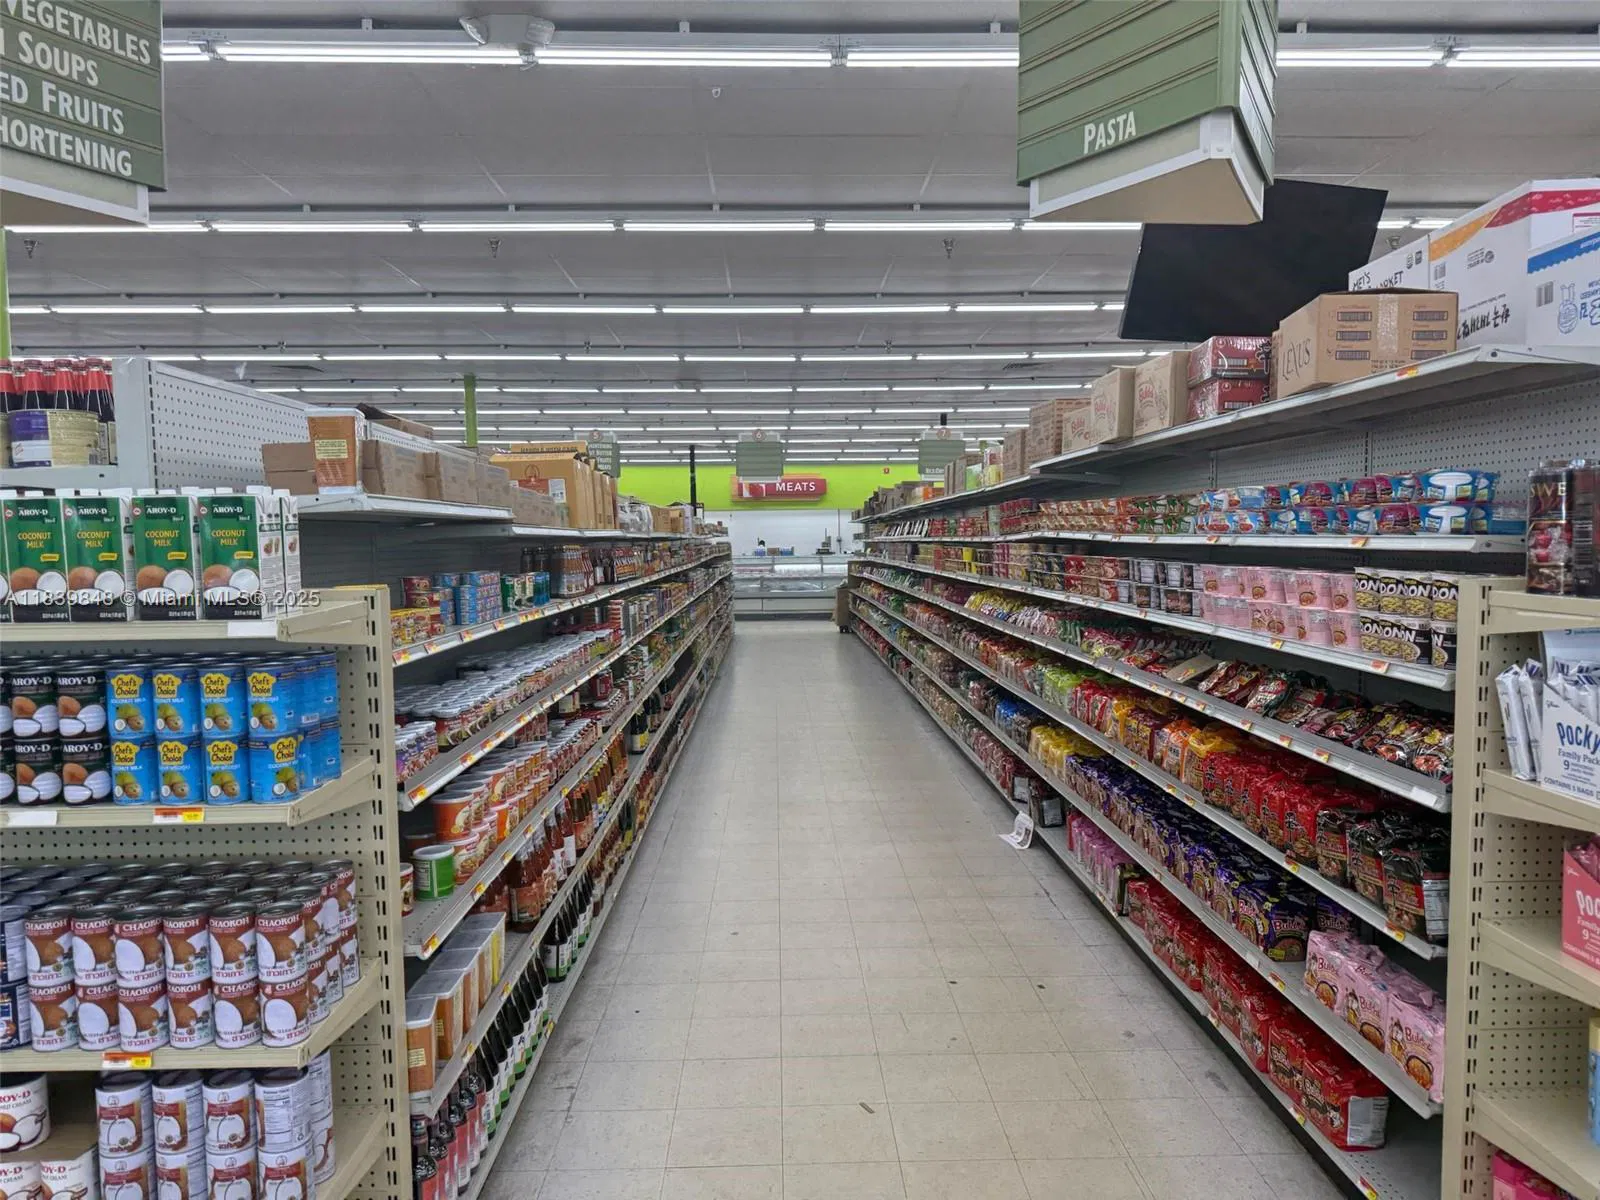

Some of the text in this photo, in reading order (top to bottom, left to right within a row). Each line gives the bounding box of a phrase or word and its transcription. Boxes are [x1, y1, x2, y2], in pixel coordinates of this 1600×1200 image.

[18, 31, 99, 87] SOUPS
[42, 80, 125, 135] FRUITS
[1083, 111, 1137, 154] PASTA
[776, 482, 816, 492] MEATS
[145, 530, 180, 538] COCONUT
[26, 540, 44, 548] MILK
[84, 540, 103, 548] MILK
[220, 538, 238, 546] MILK
[1563, 761, 1570, 770] 9
[258, 916, 300, 928] CHAOKOH
[120, 984, 162, 998] CHAOKOH
